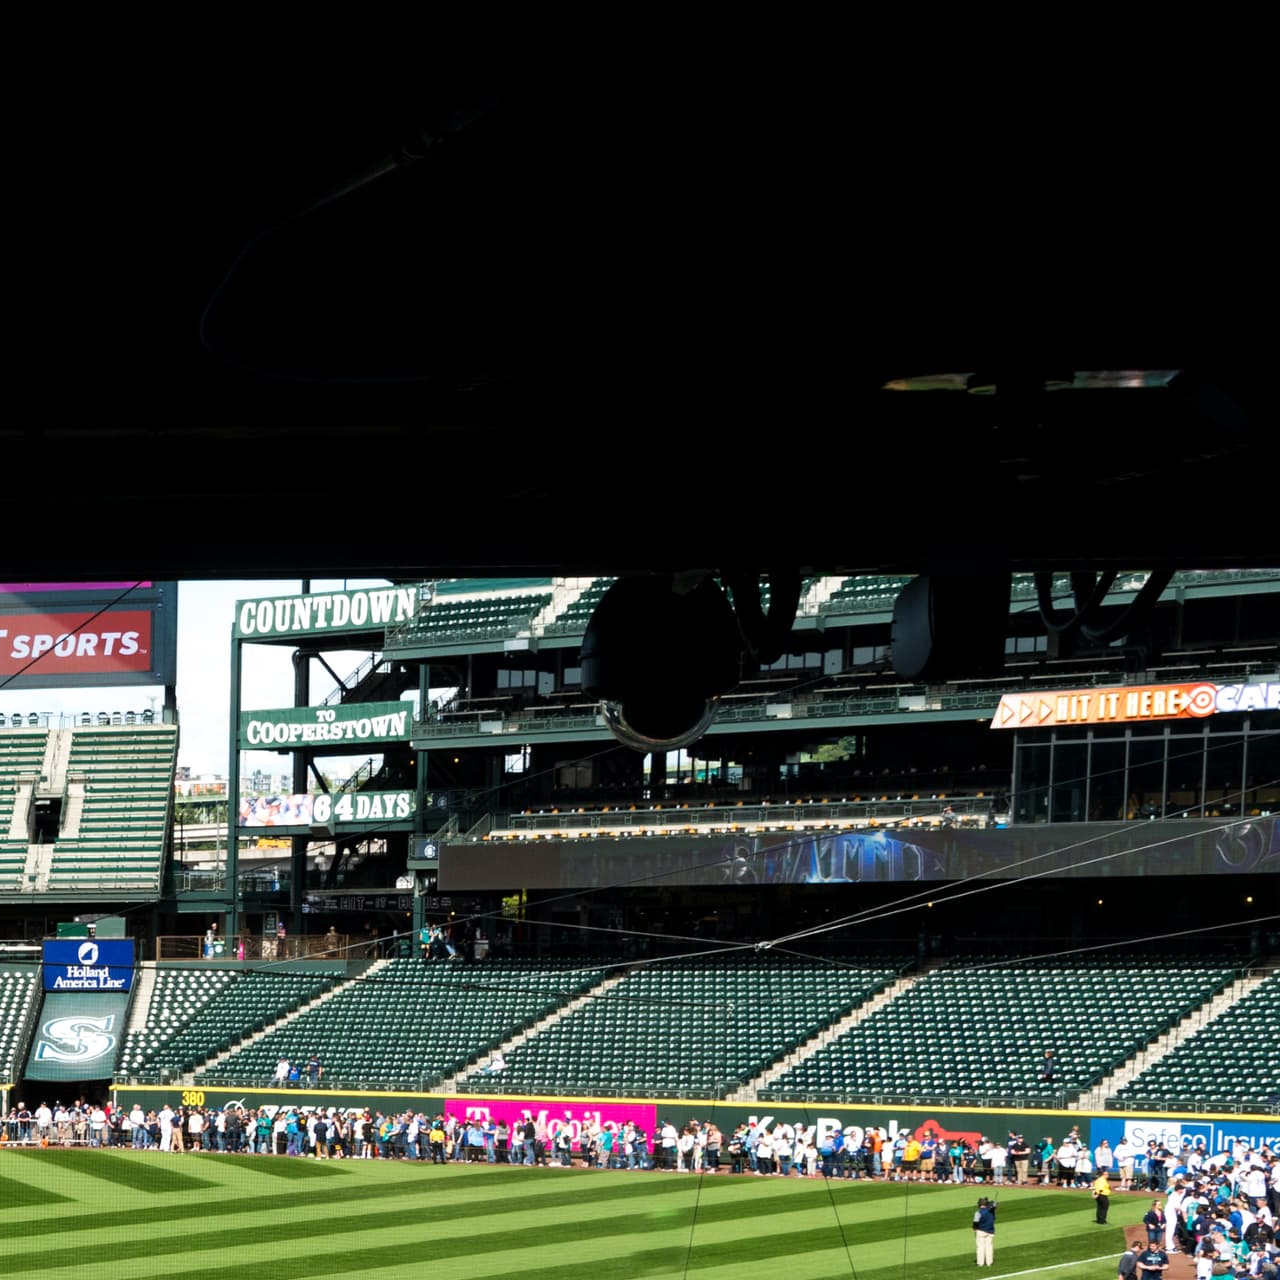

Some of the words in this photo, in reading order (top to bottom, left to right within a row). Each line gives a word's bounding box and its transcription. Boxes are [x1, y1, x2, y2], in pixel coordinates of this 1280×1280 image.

[240, 587, 417, 635] COUNTDOWN
[11, 631, 139, 659] SPORTS
[316, 710, 336, 723] TO
[1056, 696, 1090, 722] HIT
[1097, 695, 1119, 720] IT
[1126, 691, 1179, 718] HERE
[247, 711, 407, 744] COOPERSTOWN
[356, 793, 410, 819] DAYS
[53, 976, 98, 989] America
[99, 976, 123, 989] Line
[67, 966, 109, 978] Holland
[182, 1091, 205, 1107] 380
[748, 1115, 911, 1154] KeBank
